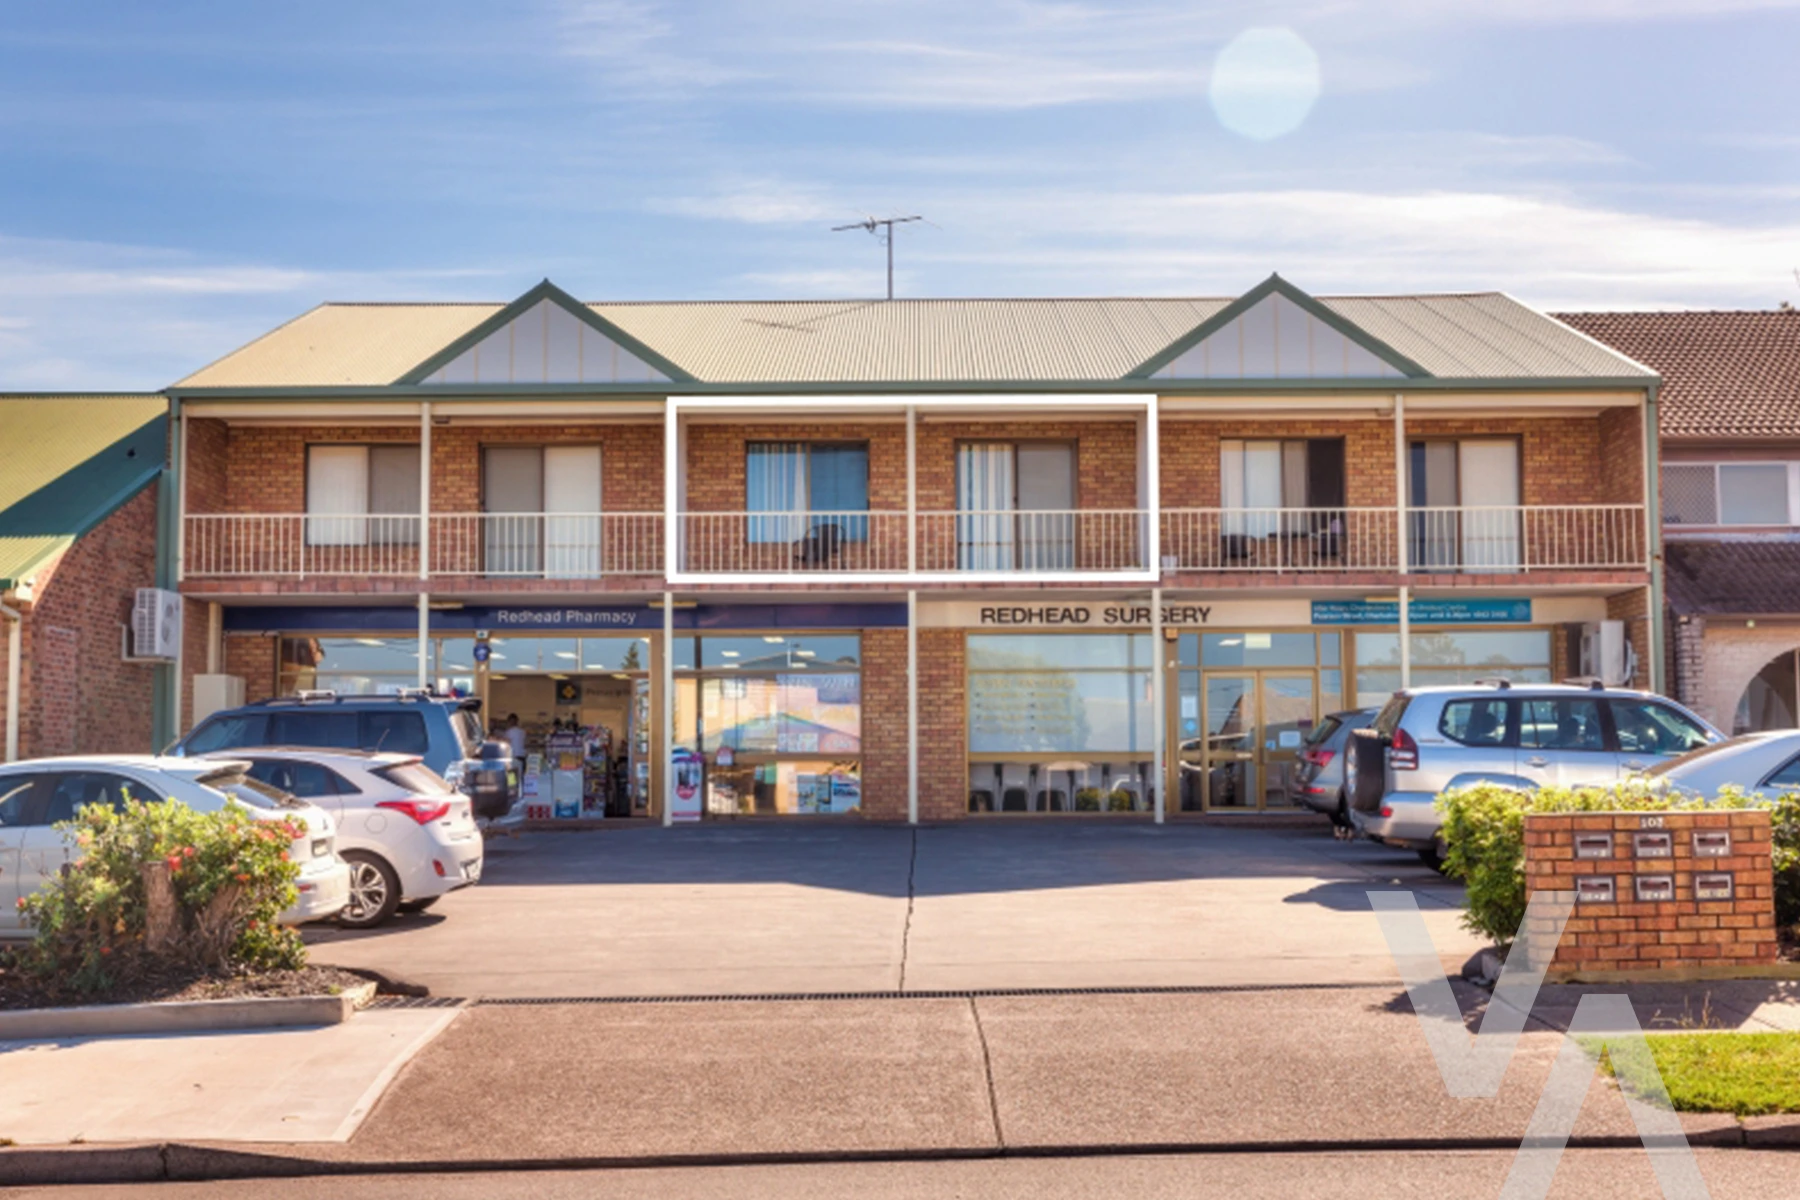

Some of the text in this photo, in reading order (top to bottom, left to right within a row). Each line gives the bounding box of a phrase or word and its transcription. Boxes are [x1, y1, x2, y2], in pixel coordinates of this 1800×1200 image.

[497, 609, 637, 625] Redhead Pharmacy
[981, 607, 1090, 624] REDHEAD
